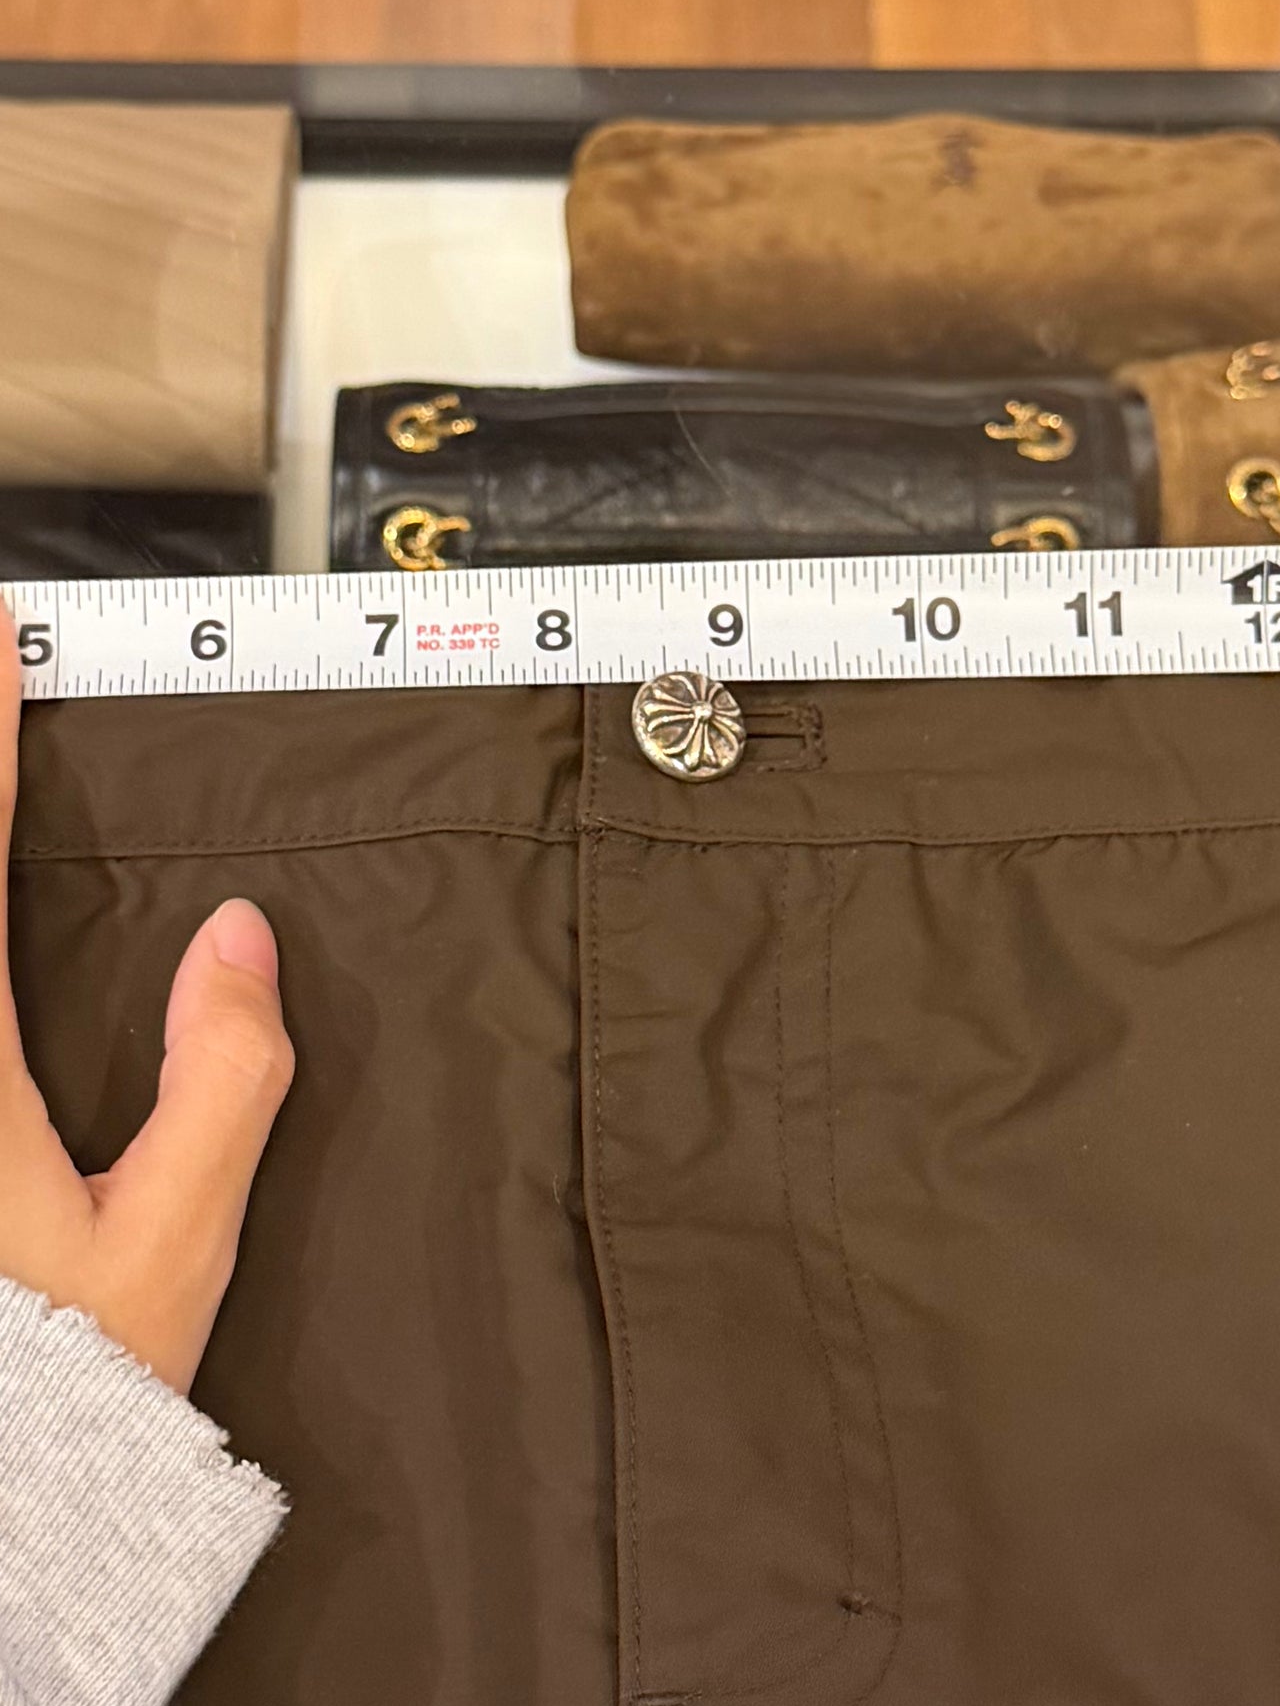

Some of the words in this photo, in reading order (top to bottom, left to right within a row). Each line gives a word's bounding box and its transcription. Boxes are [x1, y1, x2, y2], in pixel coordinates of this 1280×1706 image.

[364, 613, 400, 657] 7
[416, 624, 446, 637] P.R.
[450, 623, 500, 636] APP'D
[534, 609, 573, 652] 8
[706, 603, 744, 648] 9
[891, 596, 962, 643] 10
[1063, 590, 1123, 638] 11
[17, 623, 54, 667] 5
[189, 619, 229, 662] 6
[416, 640, 446, 651] NO.
[448, 639, 476, 651] 339
[481, 637, 501, 650] TC
